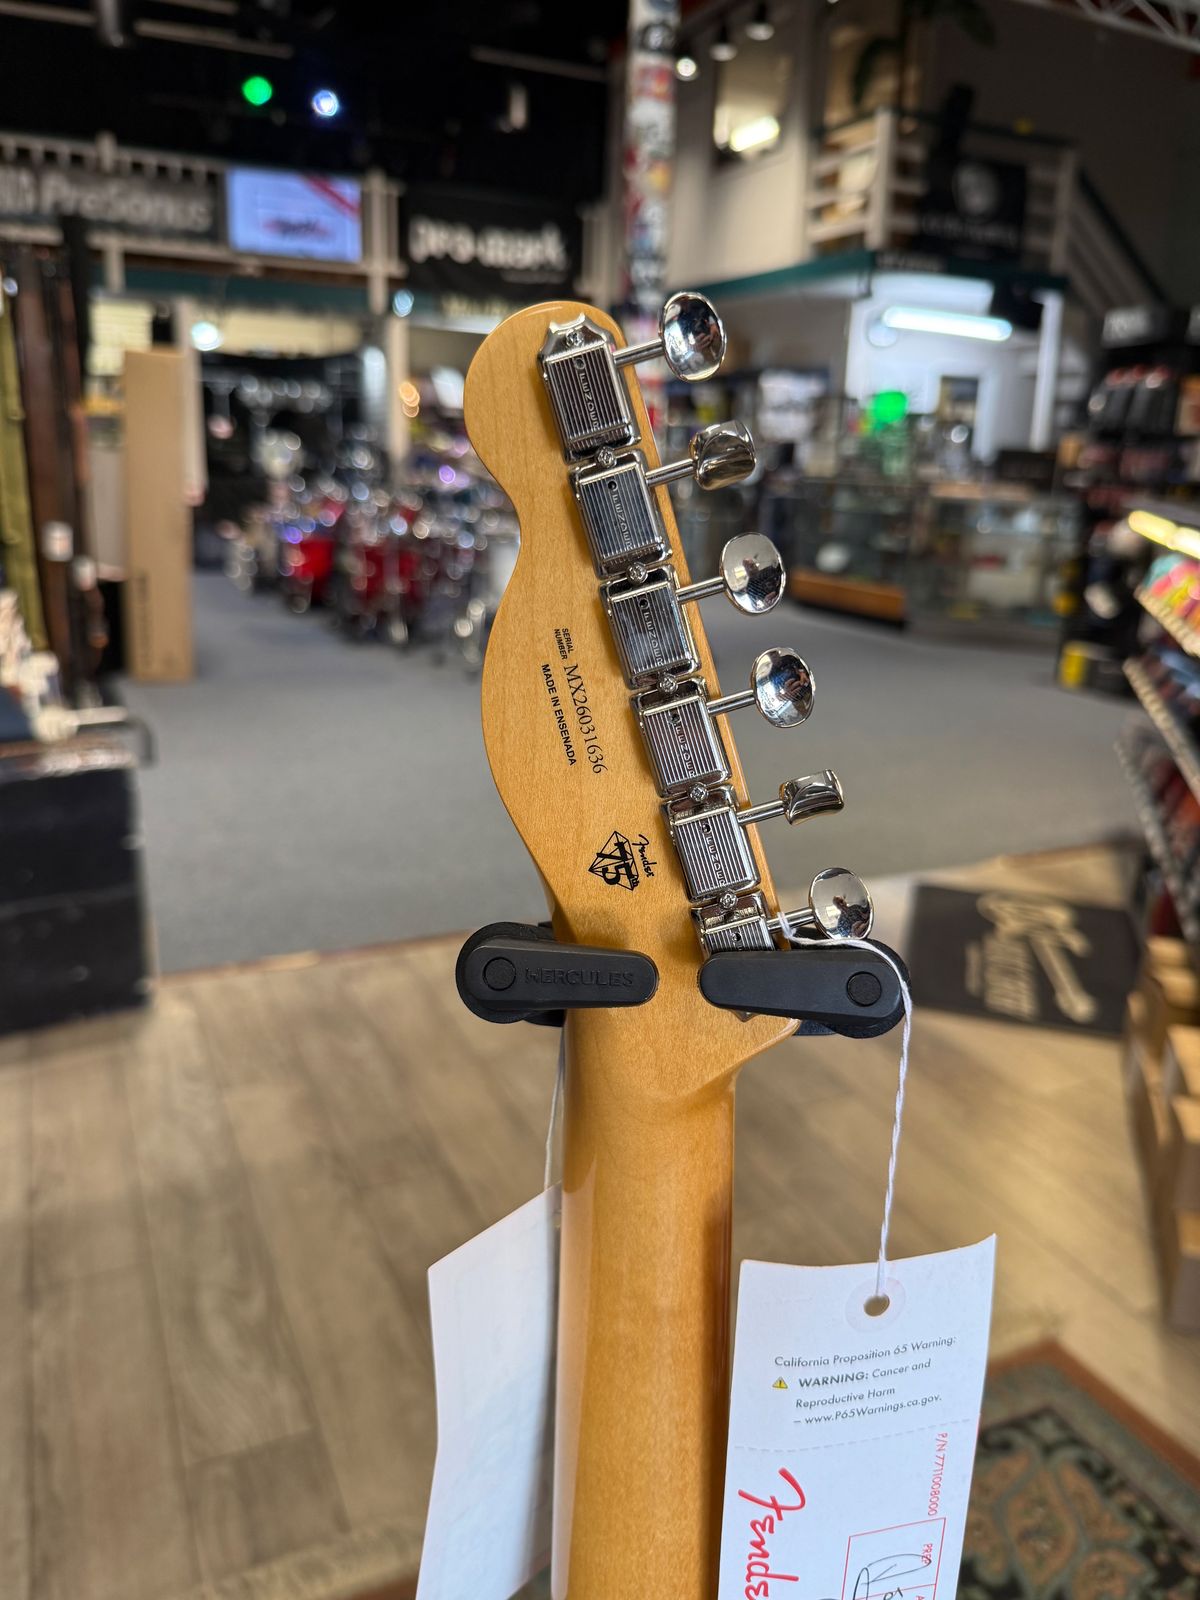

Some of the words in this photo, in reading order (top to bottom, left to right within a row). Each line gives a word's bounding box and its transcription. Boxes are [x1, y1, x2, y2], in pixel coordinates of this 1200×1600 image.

[554, 628, 568, 660] NUMBER
[561, 627, 575, 654] SERIAL
[541, 663, 557, 695] MADE
[551, 696, 561, 707] IN
[563, 663, 608, 774] MX26031636
[554, 708, 577, 766] ENSENADA
[632, 834, 658, 878] Fender
[525, 967, 634, 987] HERCULES
[774, 1355, 830, 1367] California
[832, 1347, 891, 1365] Proposition
[893, 1344, 908, 1355] 65
[910, 1335, 957, 1352] Warning:
[798, 1371, 869, 1388] WARNING:
[872, 1364, 910, 1379] Cancer
[911, 1358, 932, 1371] and
[795, 1392, 865, 1410] Reproductive
[867, 1386, 896, 1399] Harm
[804, 1393, 942, 1425] www.P65Warnings.ca.gov.
[935, 1432, 948, 1452] P/N
